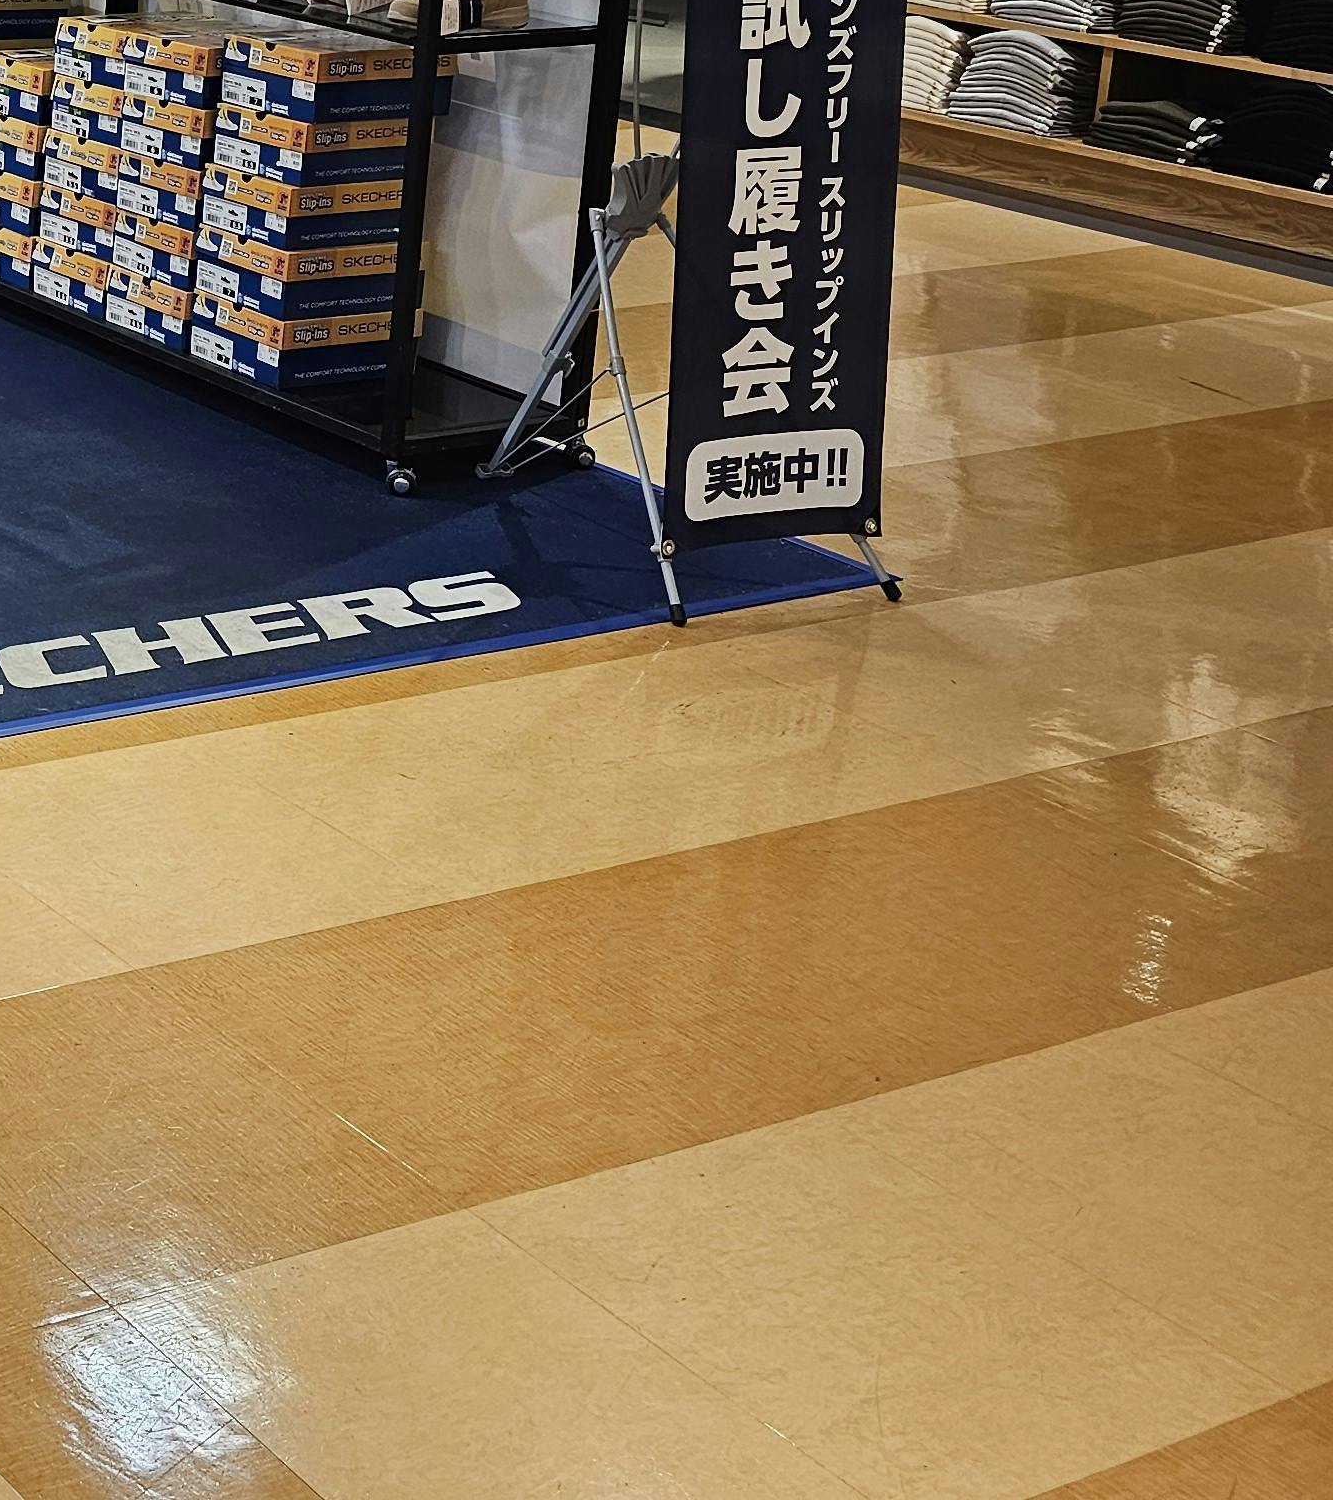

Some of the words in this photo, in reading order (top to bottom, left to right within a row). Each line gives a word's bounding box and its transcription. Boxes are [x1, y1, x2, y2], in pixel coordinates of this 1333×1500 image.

[329, 60, 365, 76] Slip-ins
[373, 57, 450, 69] SKECS
[341, 105, 369, 114] COMFORT
[369, 104, 403, 113] TECHNOLOGY
[315, 131, 348, 145] Slip-ins
[356, 127, 409, 139] SKECHE
[326, 168, 350, 176] COMFORT
[351, 166, 384, 174] TECHNOLOGY
[300, 197, 332, 211] Slip-ins
[298, 260, 333, 275] Slip-ins
[809, 176, 848, 412] スリップインズ
[311, 300, 337, 309] COMFORT
[338, 298, 374, 306] TECHNOLOGY
[294, 328, 329, 343] Slip-ins
[338, 322, 392, 336] SKECHE
[703, 446, 850, 504] 実施中!!
